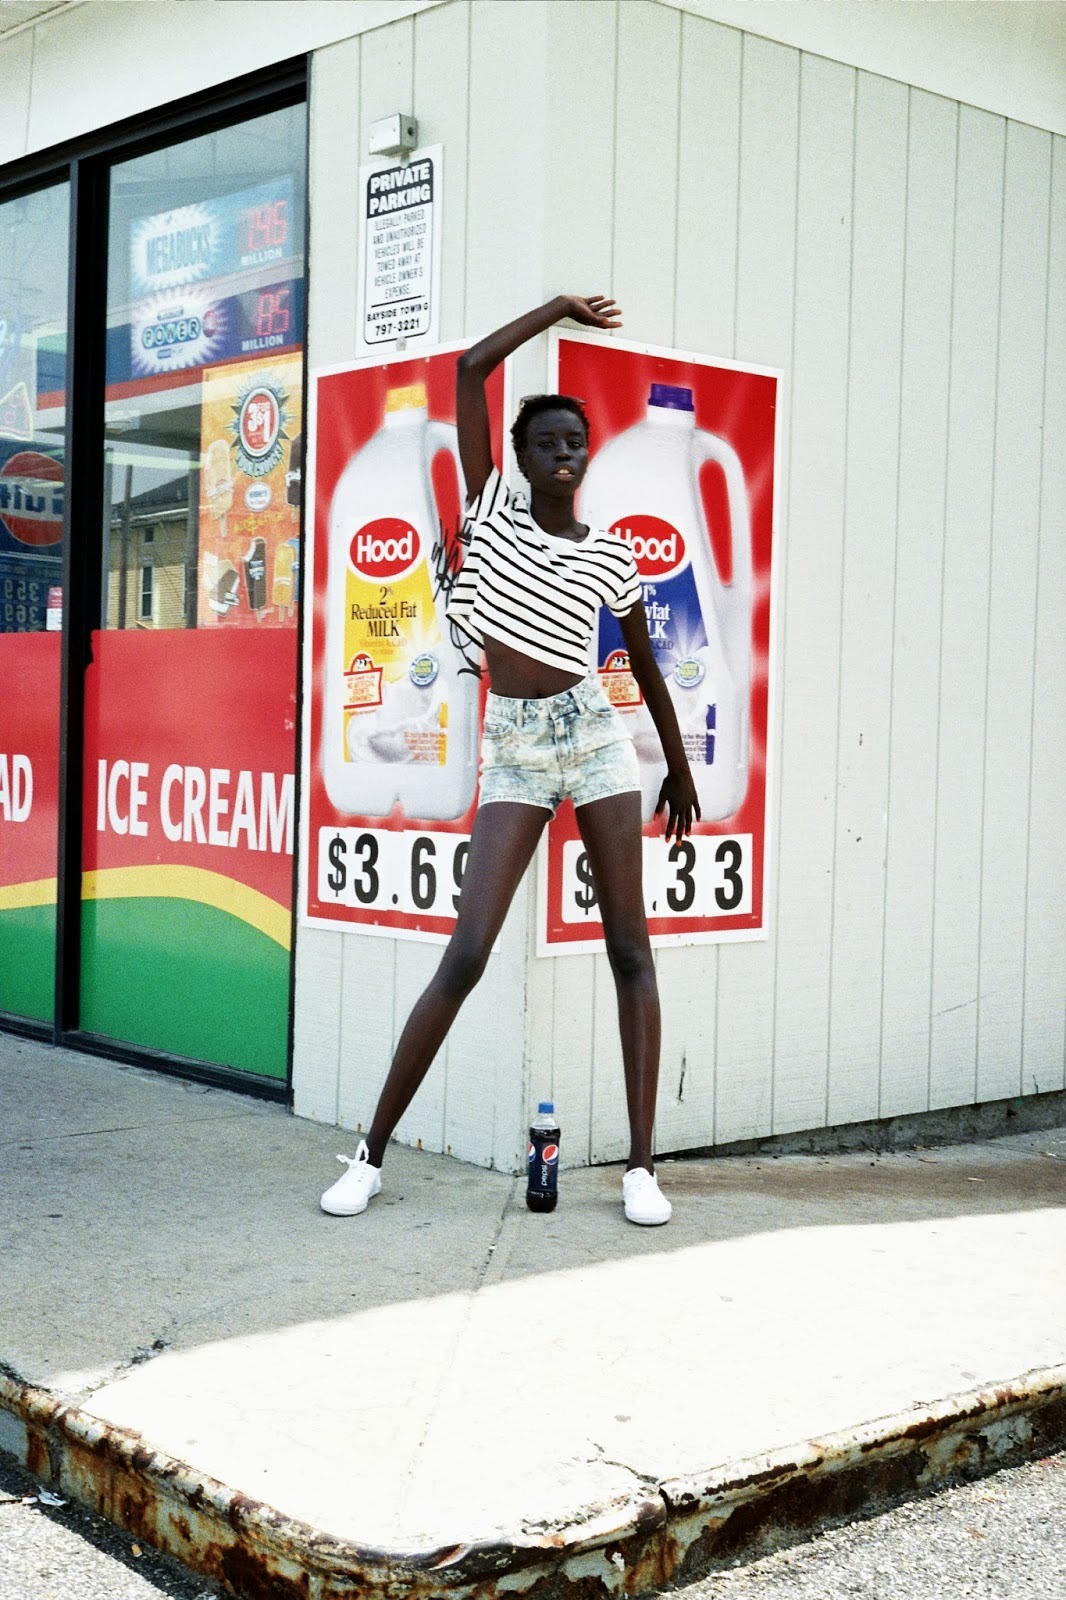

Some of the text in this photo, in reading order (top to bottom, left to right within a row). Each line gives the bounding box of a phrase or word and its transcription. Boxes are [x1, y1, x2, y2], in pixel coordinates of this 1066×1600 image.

[370, 162, 430, 194] PRIVATE
[369, 184, 431, 215] PARKING
[404, 209, 425, 222] PARKED
[373, 223, 426, 245] AND UNAUTHORIZED
[240, 247, 283, 266] MILLION
[374, 238, 425, 259] VEHICLES WILL BE
[377, 252, 421, 272] TOWED AWAY AT
[374, 266, 423, 287] VEHICLE OWNER'S
[384, 283, 410, 299] EXPENSE
[367, 308, 397, 322] BAYSIDE
[144, 318, 199, 348] POWER
[375, 317, 420, 336] 797-3221
[241, 334, 284, 351] MILLION
[357, 531, 413, 563] Hood
[615, 528, 676, 562] Hood
[351, 600, 417, 620] Reduced Fat
[645, 601, 670, 620] wfat
[366, 619, 400, 637] MILK
[647, 620, 668, 639] LK
[97, 759, 295, 855] ICE CREAM
[574, 839, 743, 915] $.33
